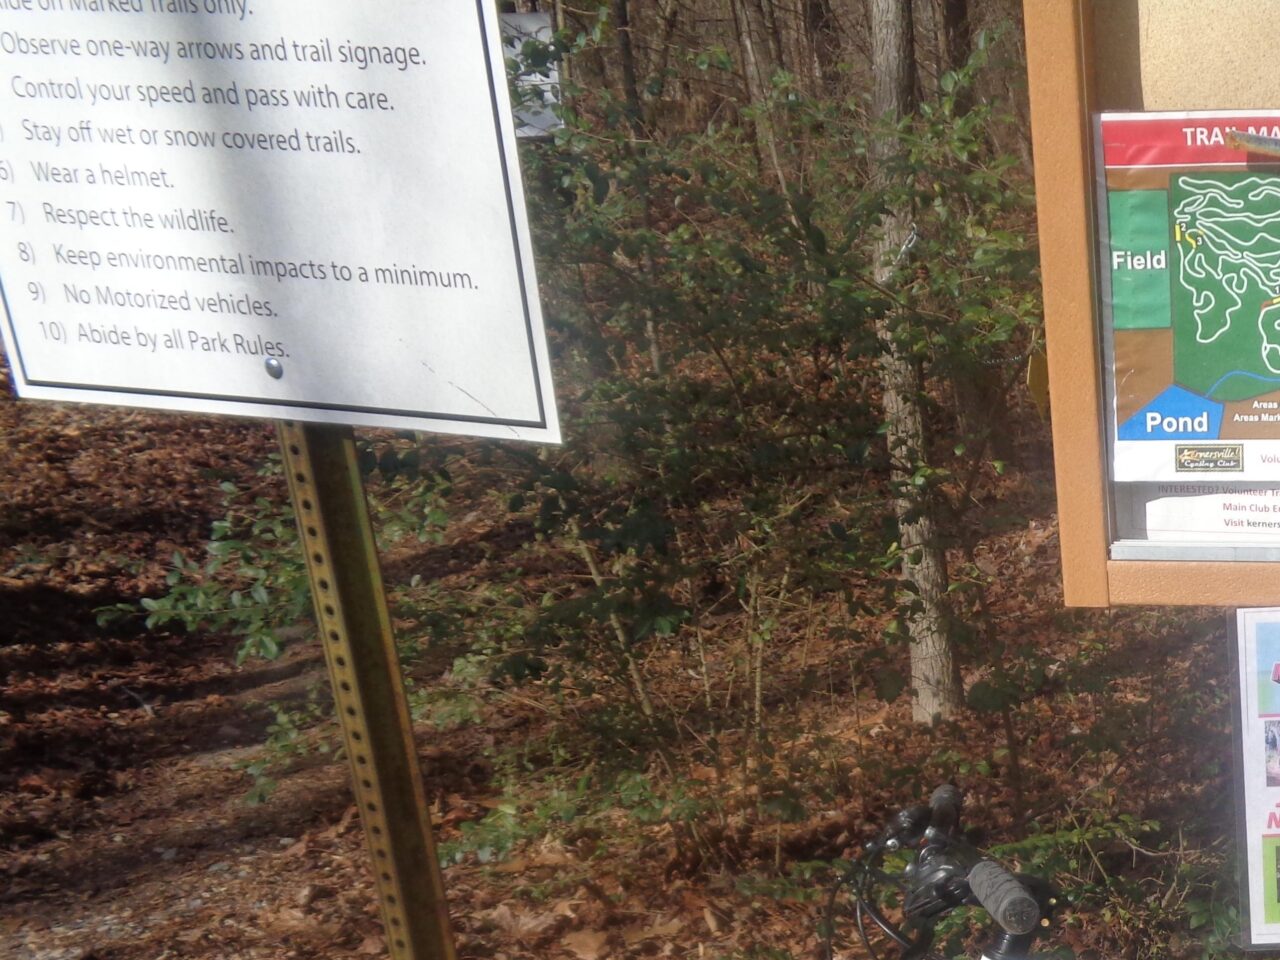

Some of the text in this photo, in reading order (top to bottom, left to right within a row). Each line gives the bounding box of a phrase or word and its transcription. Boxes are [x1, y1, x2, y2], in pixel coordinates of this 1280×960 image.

[0, 31, 426, 71] Observe one-way arrows and trail signage.
[11, 75, 394, 111] Control your speed and pass with care.
[21, 119, 61, 147] Stay
[68, 120, 93, 142] off
[98, 125, 135, 144] wet
[140, 128, 158, 145] or
[165, 128, 215, 148] snow
[222, 128, 301, 151] covered
[306, 130, 361, 154] trails.
[30, 161, 174, 189] Wear a helmet.
[6, 201, 234, 233] 7) Respect the wildlife.
[18, 242, 479, 290] 8) Keep environmental impacts to a minimum.
[1113, 252, 1166, 270] Field
[27, 281, 278, 317] 9) No Motorized vehicles.
[39, 321, 290, 358] 10) Abide by all Park Rules.
[1234, 414, 1259, 422] Areas
[1253, 401, 1278, 410] Areas
[1146, 412, 1208, 433] Pond
[1222, 487, 1268, 497] Volunteer
[1223, 503, 1247, 513] Main
[1249, 504, 1270, 513] Club
[1224, 518, 1245, 528] Visit
